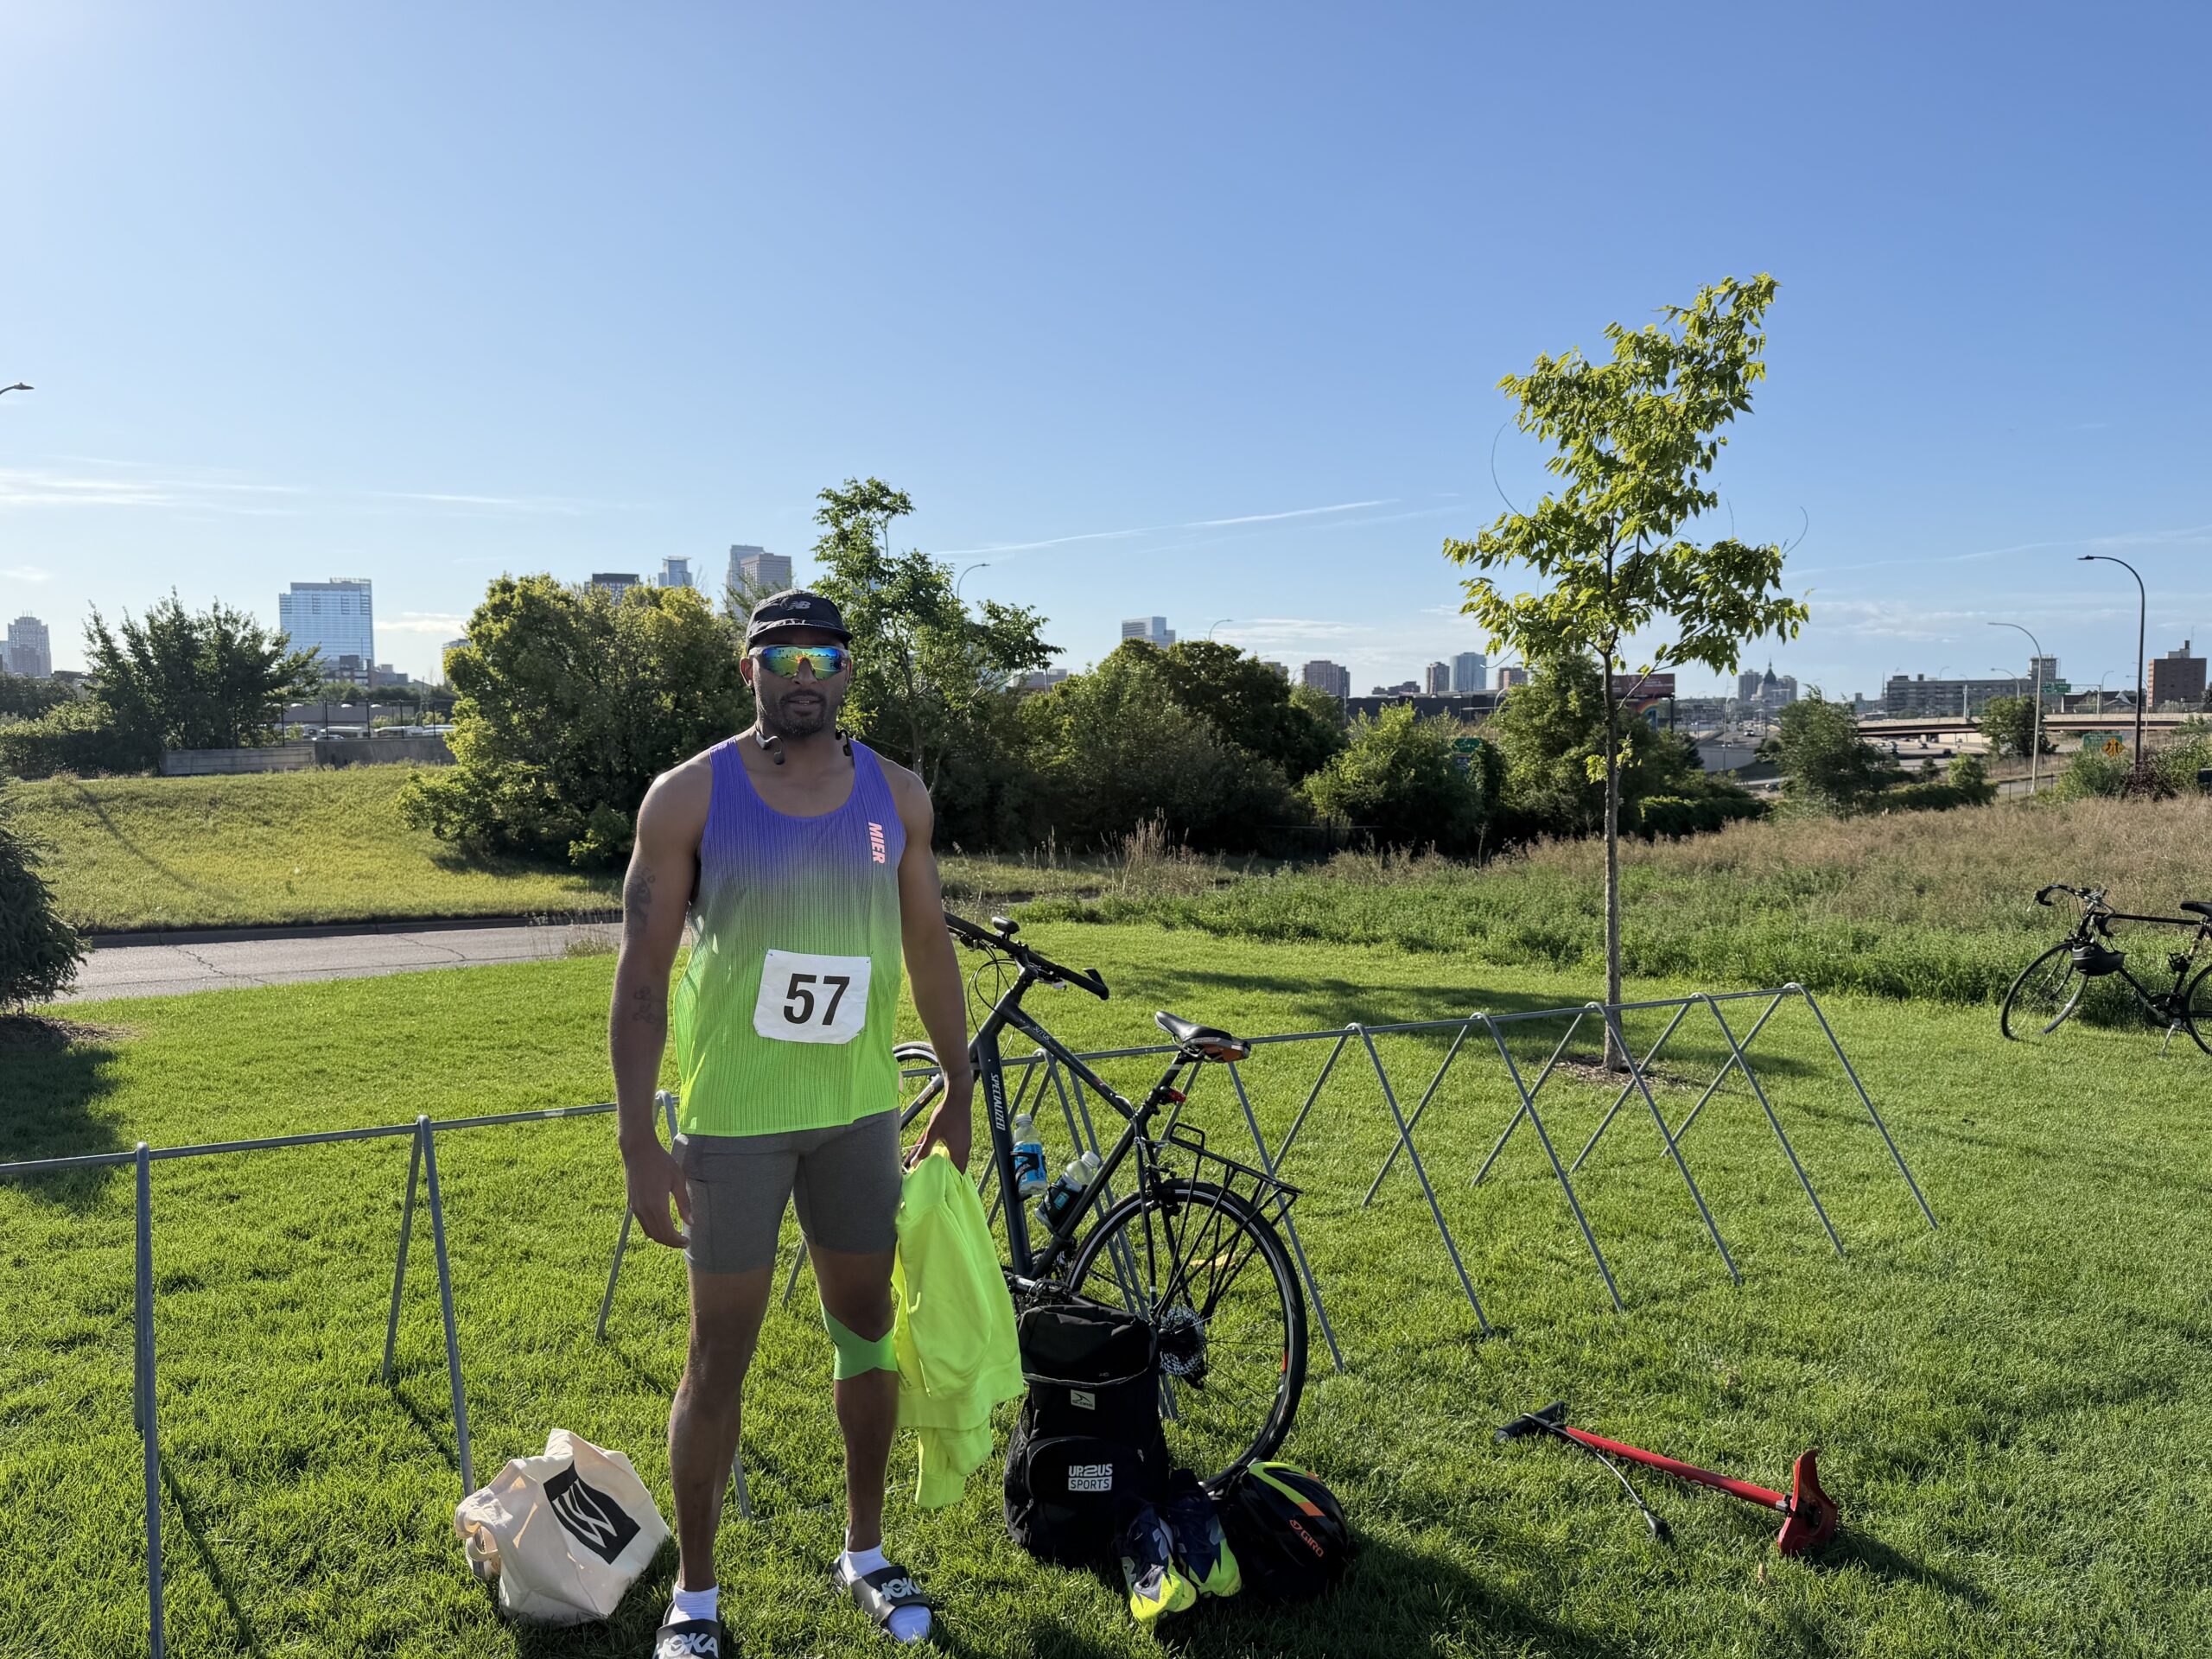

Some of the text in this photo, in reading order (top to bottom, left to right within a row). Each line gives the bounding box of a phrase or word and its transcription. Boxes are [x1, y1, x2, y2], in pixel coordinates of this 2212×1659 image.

[868, 822, 885, 863] MIER
[784, 973, 850, 1026] 57
[991, 1072, 1006, 1131] SPECIALIZED
[1070, 1478, 1109, 1490] SPORTS
[1301, 1529, 1324, 1557] GIRO
